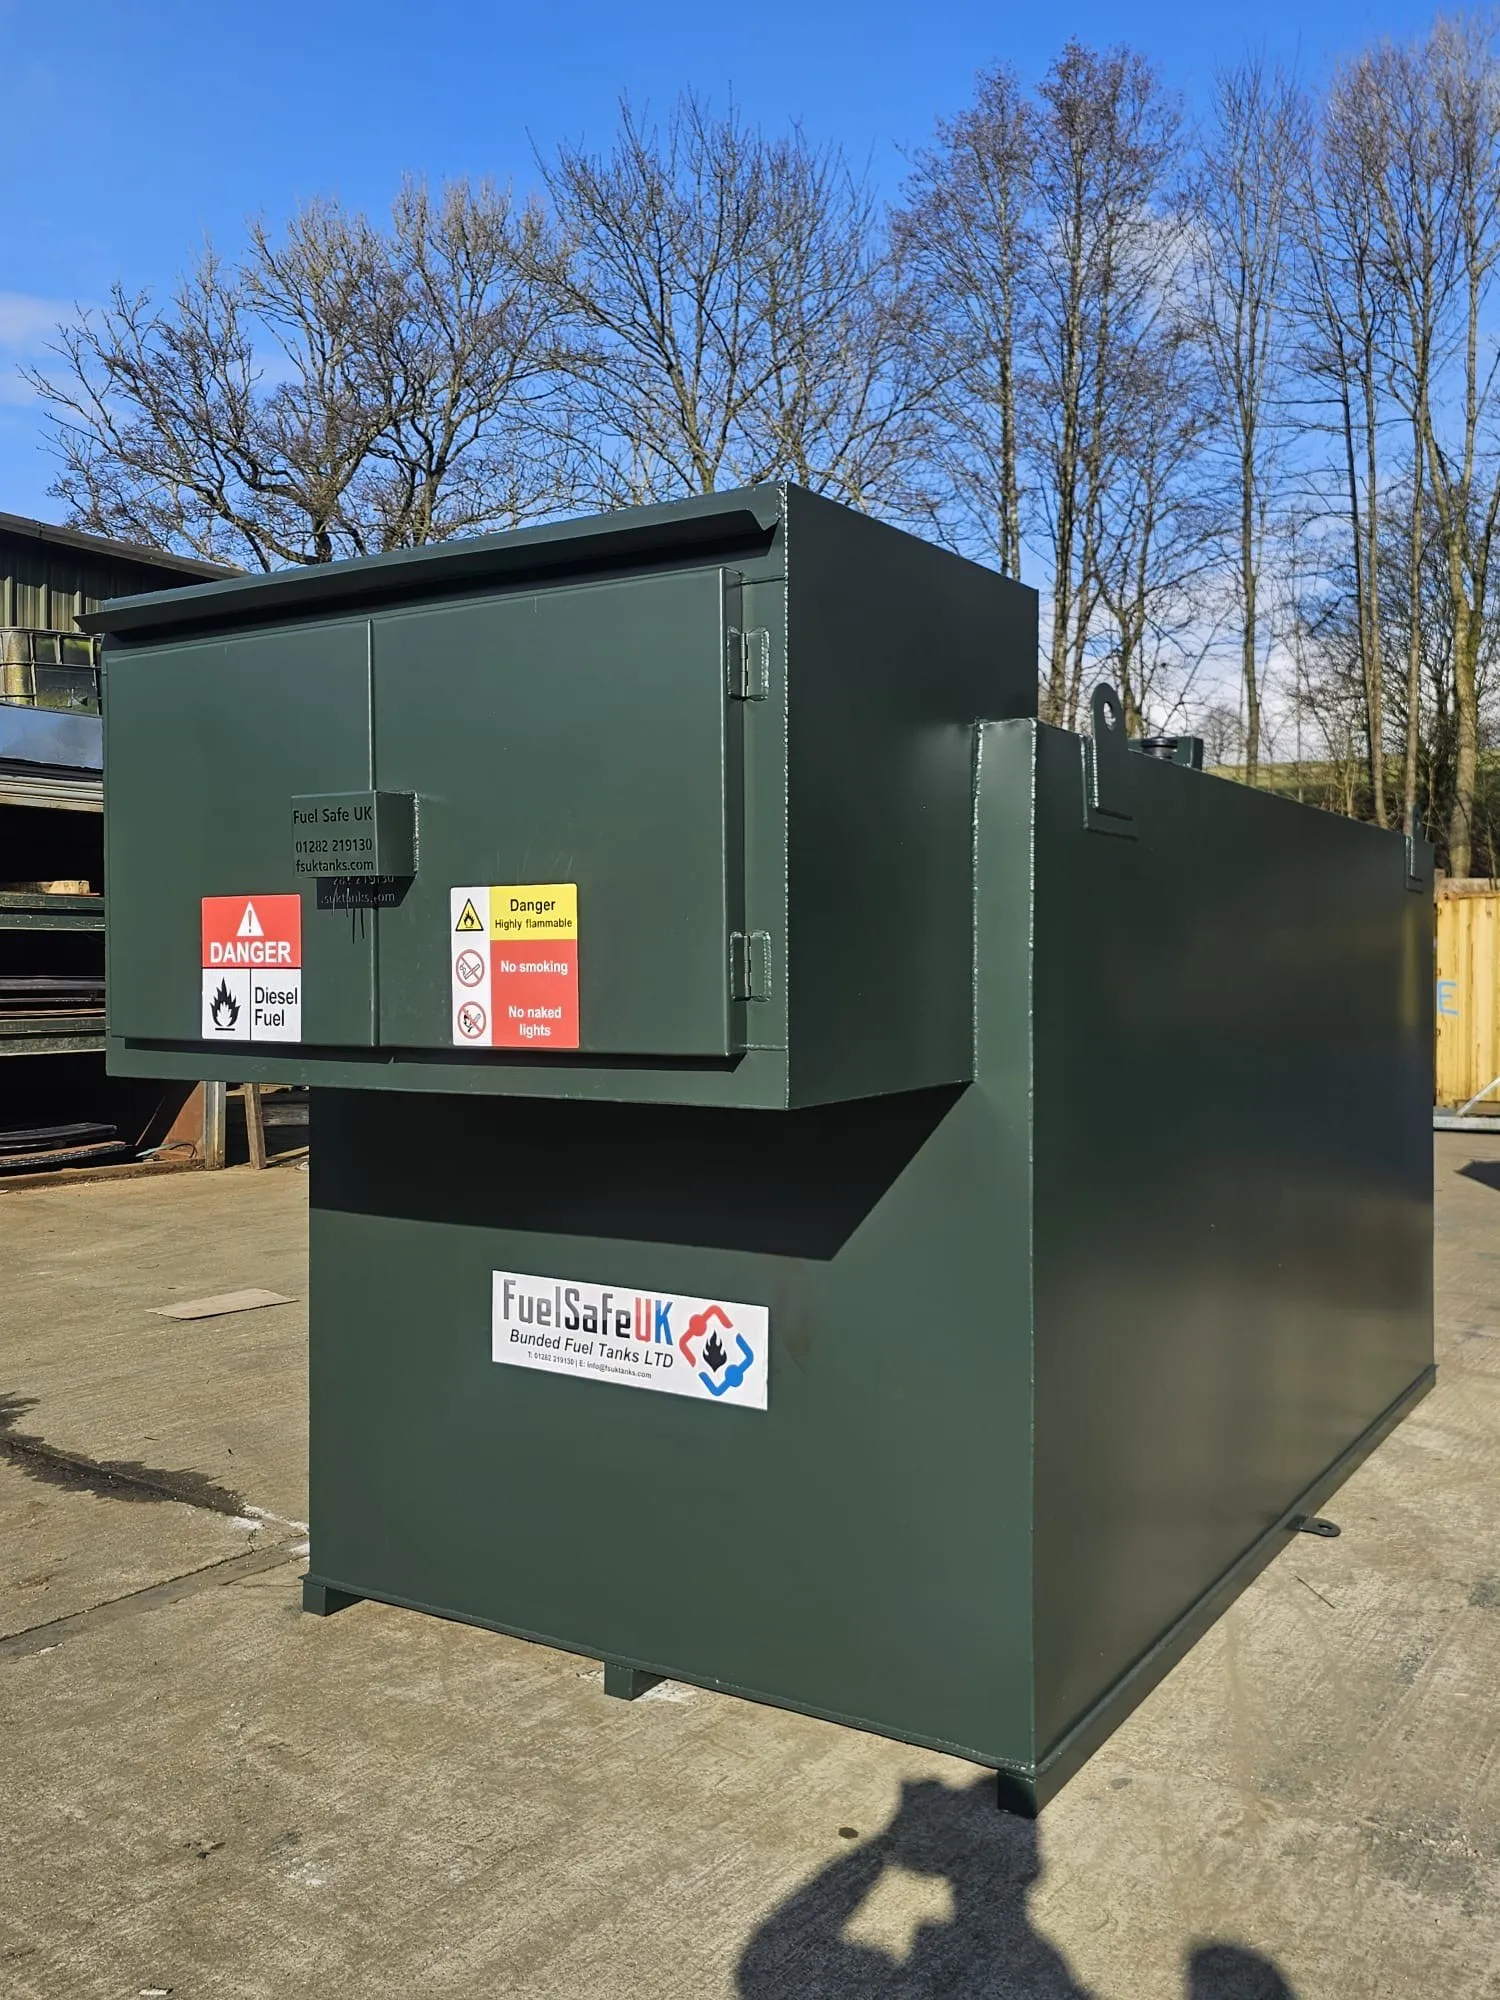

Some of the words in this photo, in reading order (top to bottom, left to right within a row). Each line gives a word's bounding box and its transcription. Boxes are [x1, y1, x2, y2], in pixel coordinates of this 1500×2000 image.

[293, 808, 318, 824] Fuel
[322, 807, 349, 822] Safe
[354, 806, 373, 821] UK
[295, 840, 328, 853] 01282
[332, 838, 373, 852] 219130
[296, 859, 374, 872] fsuktanks.com
[510, 898, 556, 914] Danger
[495, 919, 522, 931] Highly
[525, 917, 573, 929] flammable
[210, 941, 292, 963] DANGER
[500, 960, 517, 973] No
[519, 960, 568, 975] smoking
[254, 986, 298, 1005] Diesel
[255, 1008, 285, 1027] Fuel
[508, 1005, 525, 1018] No
[527, 1005, 562, 1019] naked
[519, 1024, 551, 1038] lights
[509, 1329, 560, 1350] Bunded
[564, 1338, 594, 1356] Fuel
[599, 1342, 639, 1364] Tanks
[644, 1351, 674, 1368] LTD
[586, 1361, 652, 1379] info@fsuktanks.com
